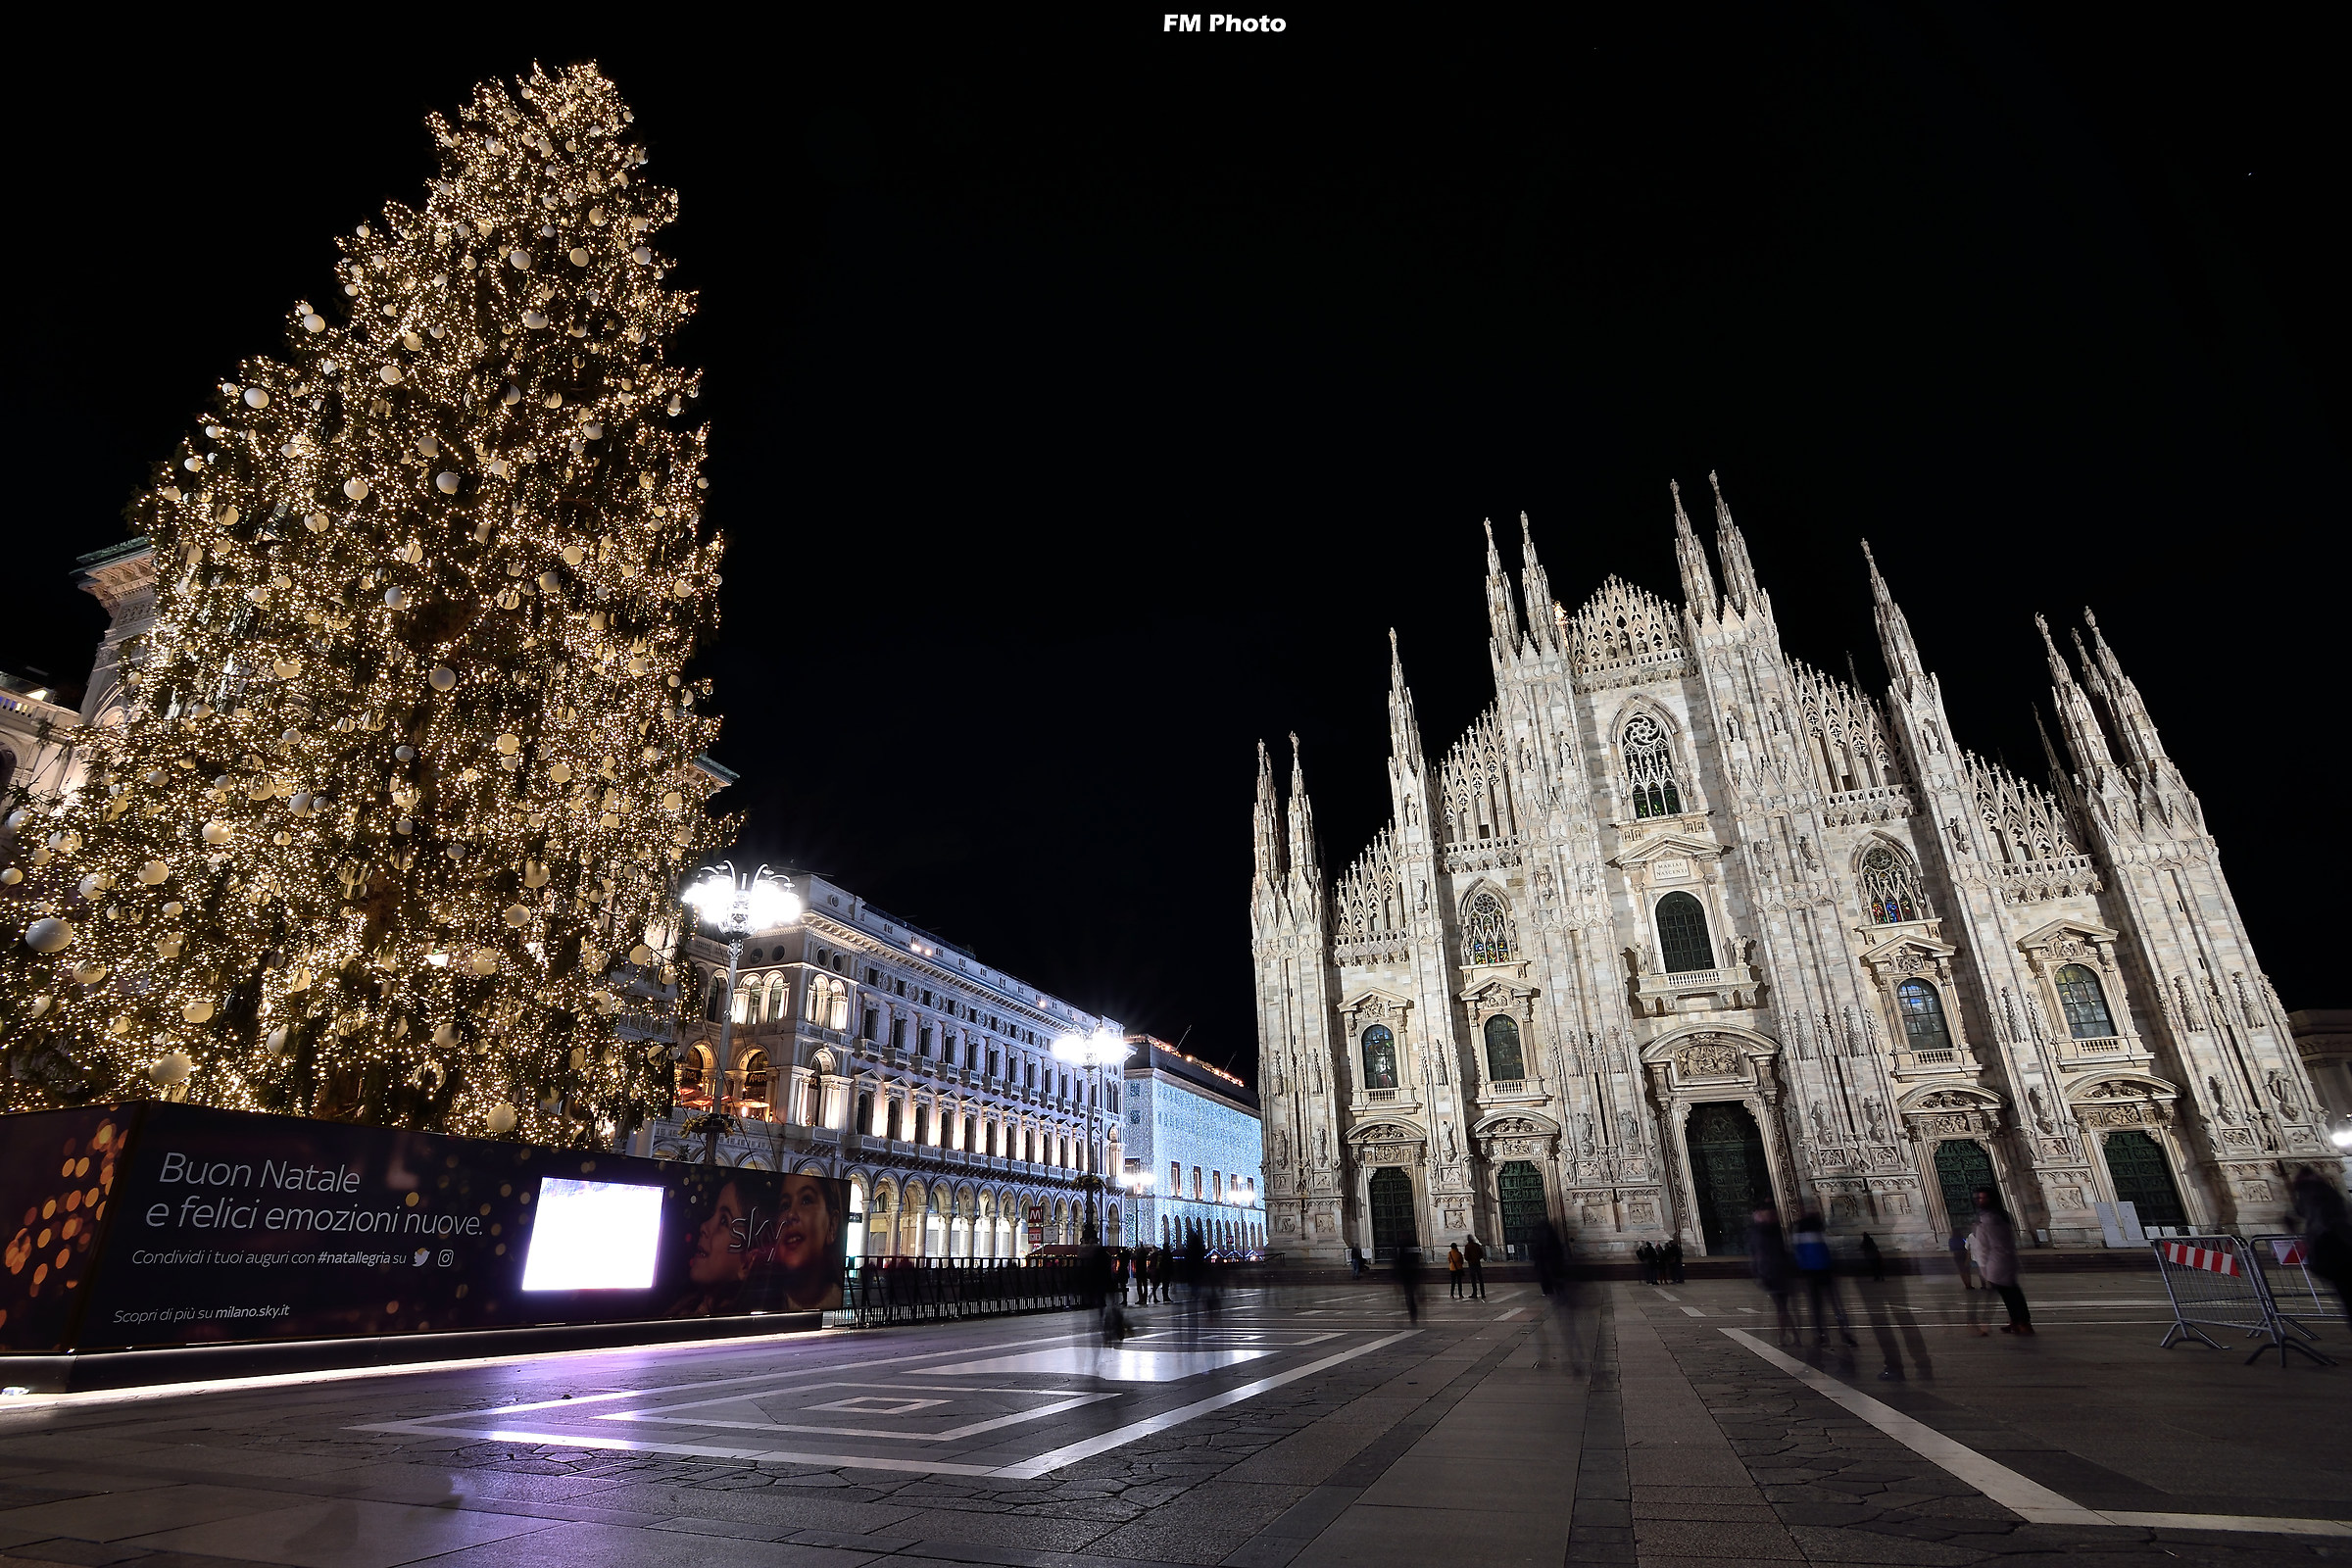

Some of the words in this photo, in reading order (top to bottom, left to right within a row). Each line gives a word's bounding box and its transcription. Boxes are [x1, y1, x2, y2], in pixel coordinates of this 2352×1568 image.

[159, 1152, 252, 1188] Buon
[260, 1159, 361, 1194] Natale
[146, 1201, 170, 1227] e
[177, 1195, 261, 1229] felici
[265, 1202, 402, 1233] emozioni
[404, 1212, 483, 1236] nuove.
[1029, 1209, 1041, 1220] M
[728, 1205, 787, 1264] sky
[131, 1250, 206, 1264] Condividi
[206, 1250, 213, 1264] i
[214, 1250, 245, 1264] tuoi
[245, 1250, 290, 1268] auguri
[291, 1253, 316, 1264] con
[317, 1250, 391, 1267] #natallegria
[392, 1253, 408, 1264] su
[113, 1308, 159, 1325] Scopri
[159, 1307, 173, 1321] di
[173, 1306, 195, 1323] più
[197, 1308, 214, 1319] su
[215, 1303, 291, 1319] milano.sky.it
